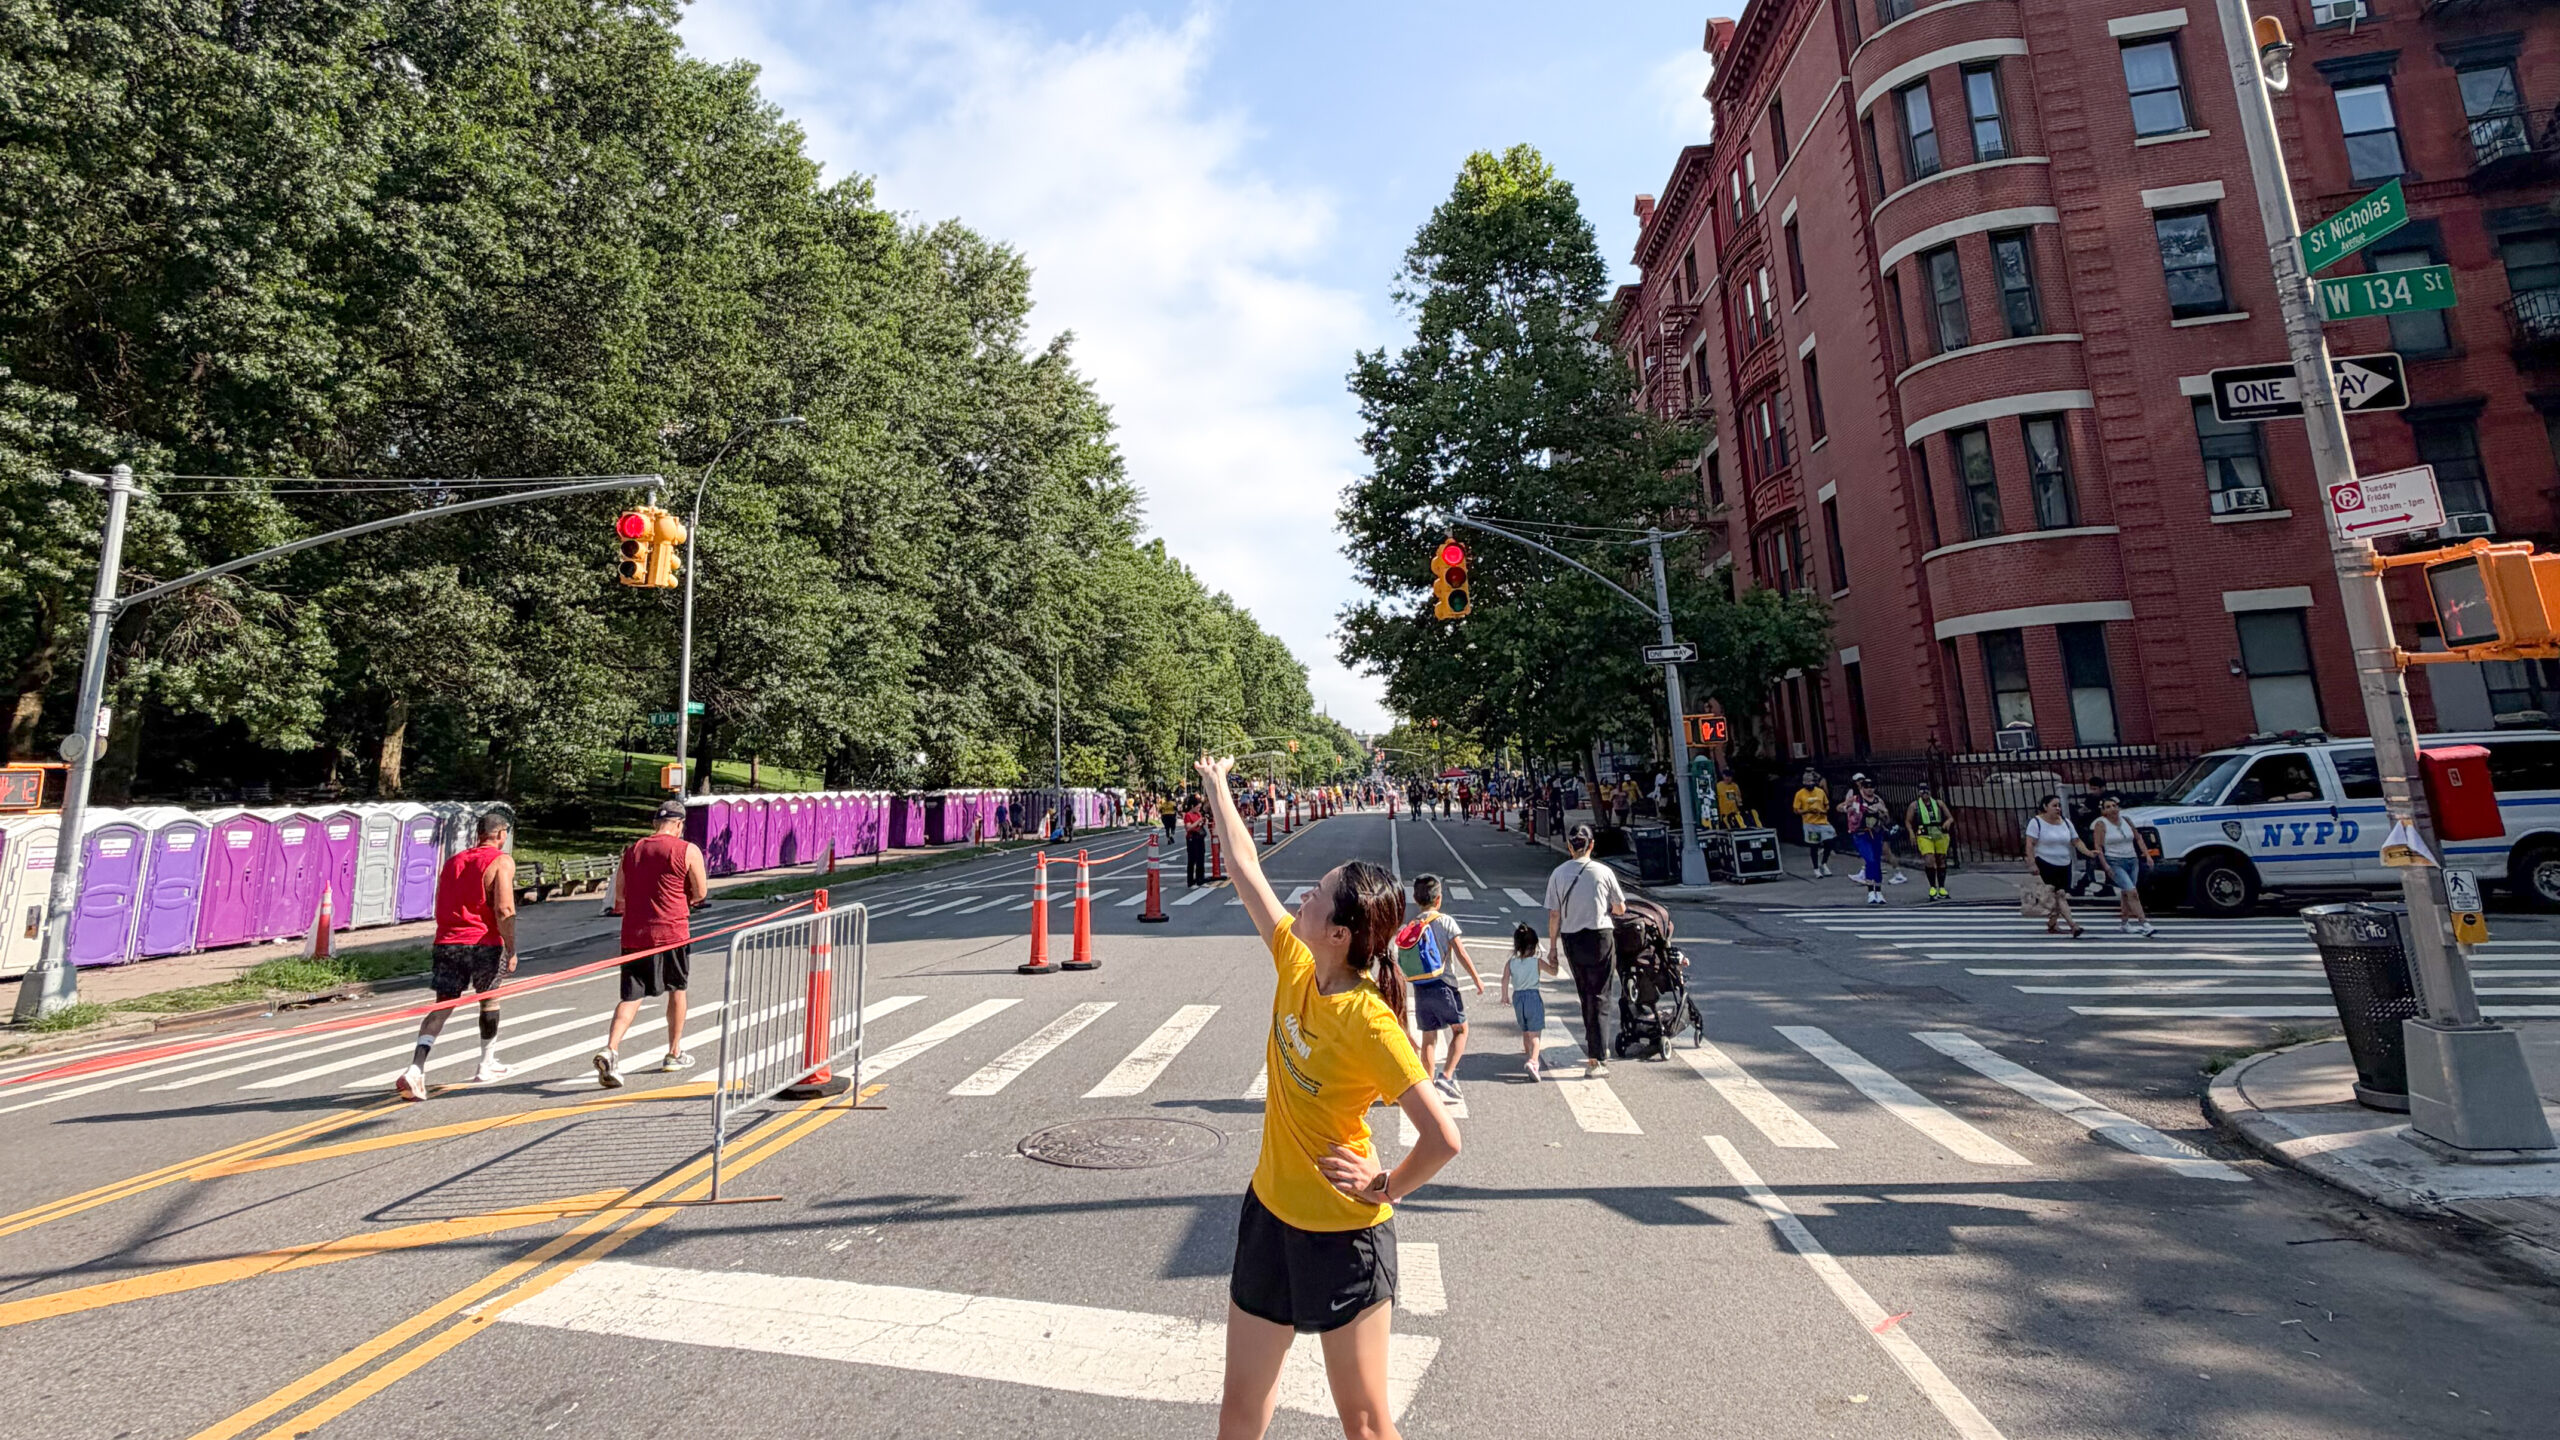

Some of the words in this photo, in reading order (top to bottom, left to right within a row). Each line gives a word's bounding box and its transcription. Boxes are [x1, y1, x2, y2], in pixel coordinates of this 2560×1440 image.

[2310, 229, 2327, 253] St
[2329, 195, 2391, 242] Nicholas
[2341, 232, 2366, 254] Avenue
[2326, 283, 2351, 314] W
[2363, 276, 2412, 310] 134
[2423, 272, 2444, 291] St
[2234, 381, 2285, 404] ONE
[2334, 373, 2369, 396] AY
[2365, 481, 2397, 493] Tuesday
[2367, 492, 2391, 502] Friday
[2408, 498, 2425, 508] 1pm
[1673, 649, 1687, 657] WAY
[2169, 815, 2200, 825] POLICE
[2261, 820, 2360, 847] NYPD
